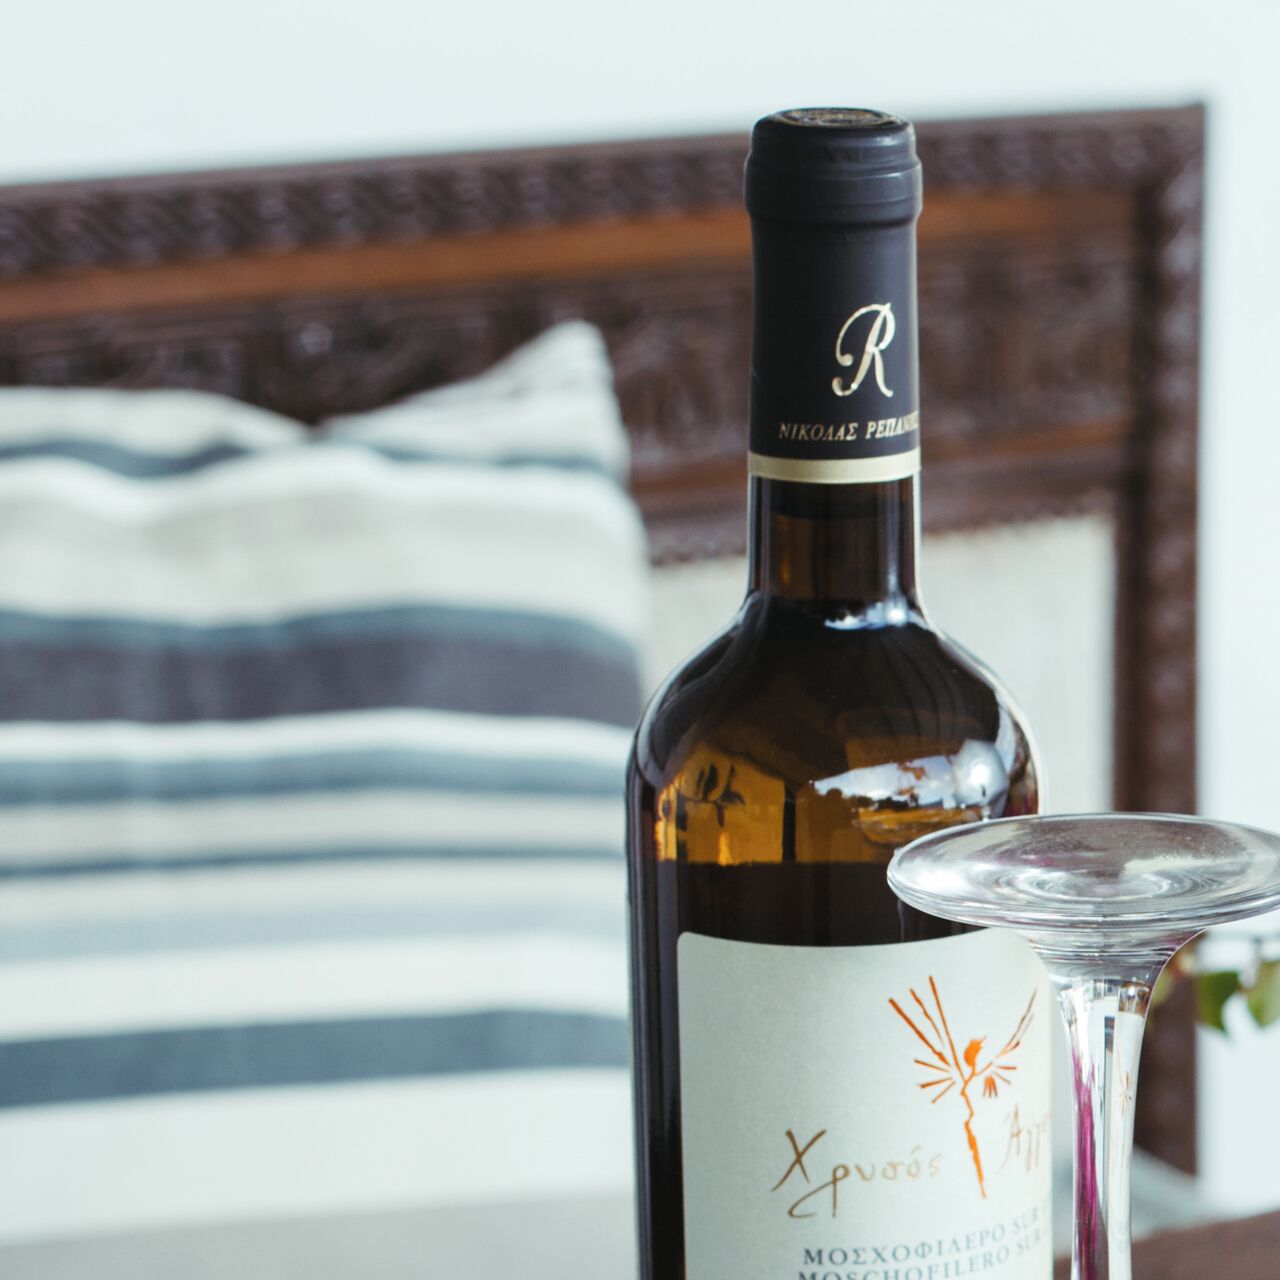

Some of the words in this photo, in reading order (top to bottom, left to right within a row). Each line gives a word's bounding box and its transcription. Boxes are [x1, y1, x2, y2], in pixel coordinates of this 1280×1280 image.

[832, 302, 896, 397] R
[778, 422, 859, 441] ΝΙΚΟΛΑΣ
[803, 1223, 1006, 1265] ΜΟΣΧΟΦΙΛΕΡΟ
